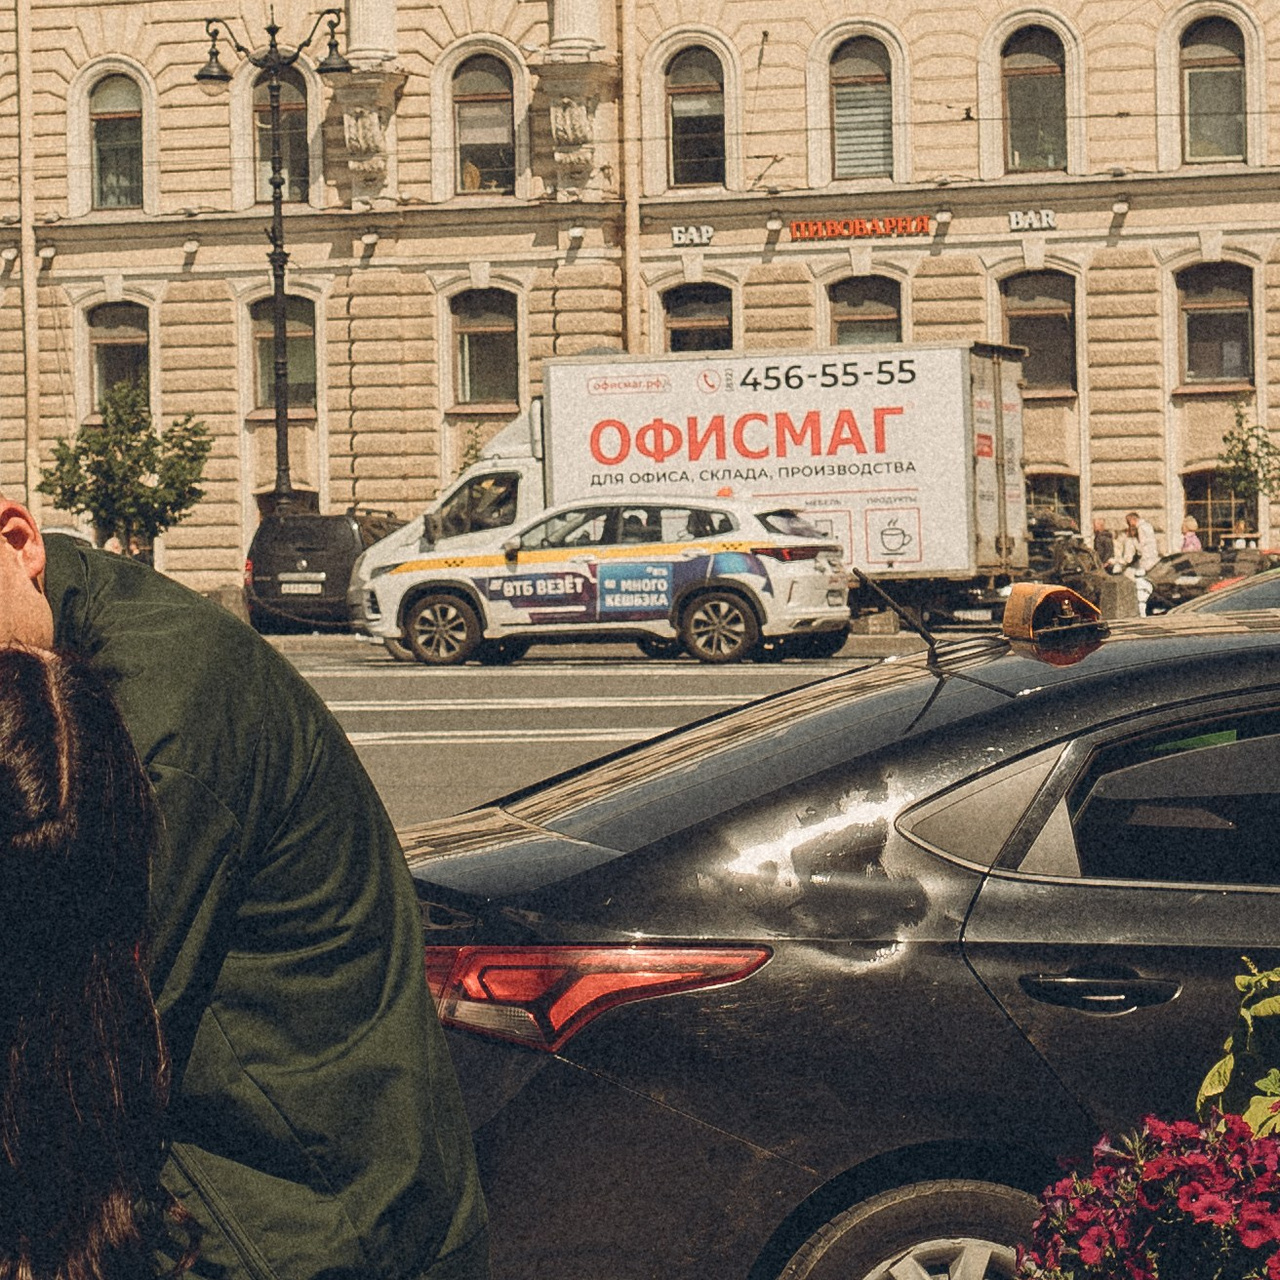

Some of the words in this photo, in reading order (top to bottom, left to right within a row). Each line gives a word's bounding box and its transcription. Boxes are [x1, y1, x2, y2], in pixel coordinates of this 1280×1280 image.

[790, 215, 931, 240] ПИВОВАРНЯ
[1009, 209, 1057, 230] BAR
[672, 226, 714, 245] БАР
[740, 360, 917, 392] 456-55-55
[589, 406, 904, 466] ОФИСМАГ
[591, 473, 624, 487] ДЛЯ
[629, 470, 695, 484] ОФИСА,
[699, 467, 773, 483] СКЛАДА,
[778, 460, 917, 480] ПРОИЗВОДСТВА
[503, 580, 534, 597] ВТБ
[536, 575, 584, 595] ВЕЗЁТ
[621, 579, 668, 592] МНОГО
